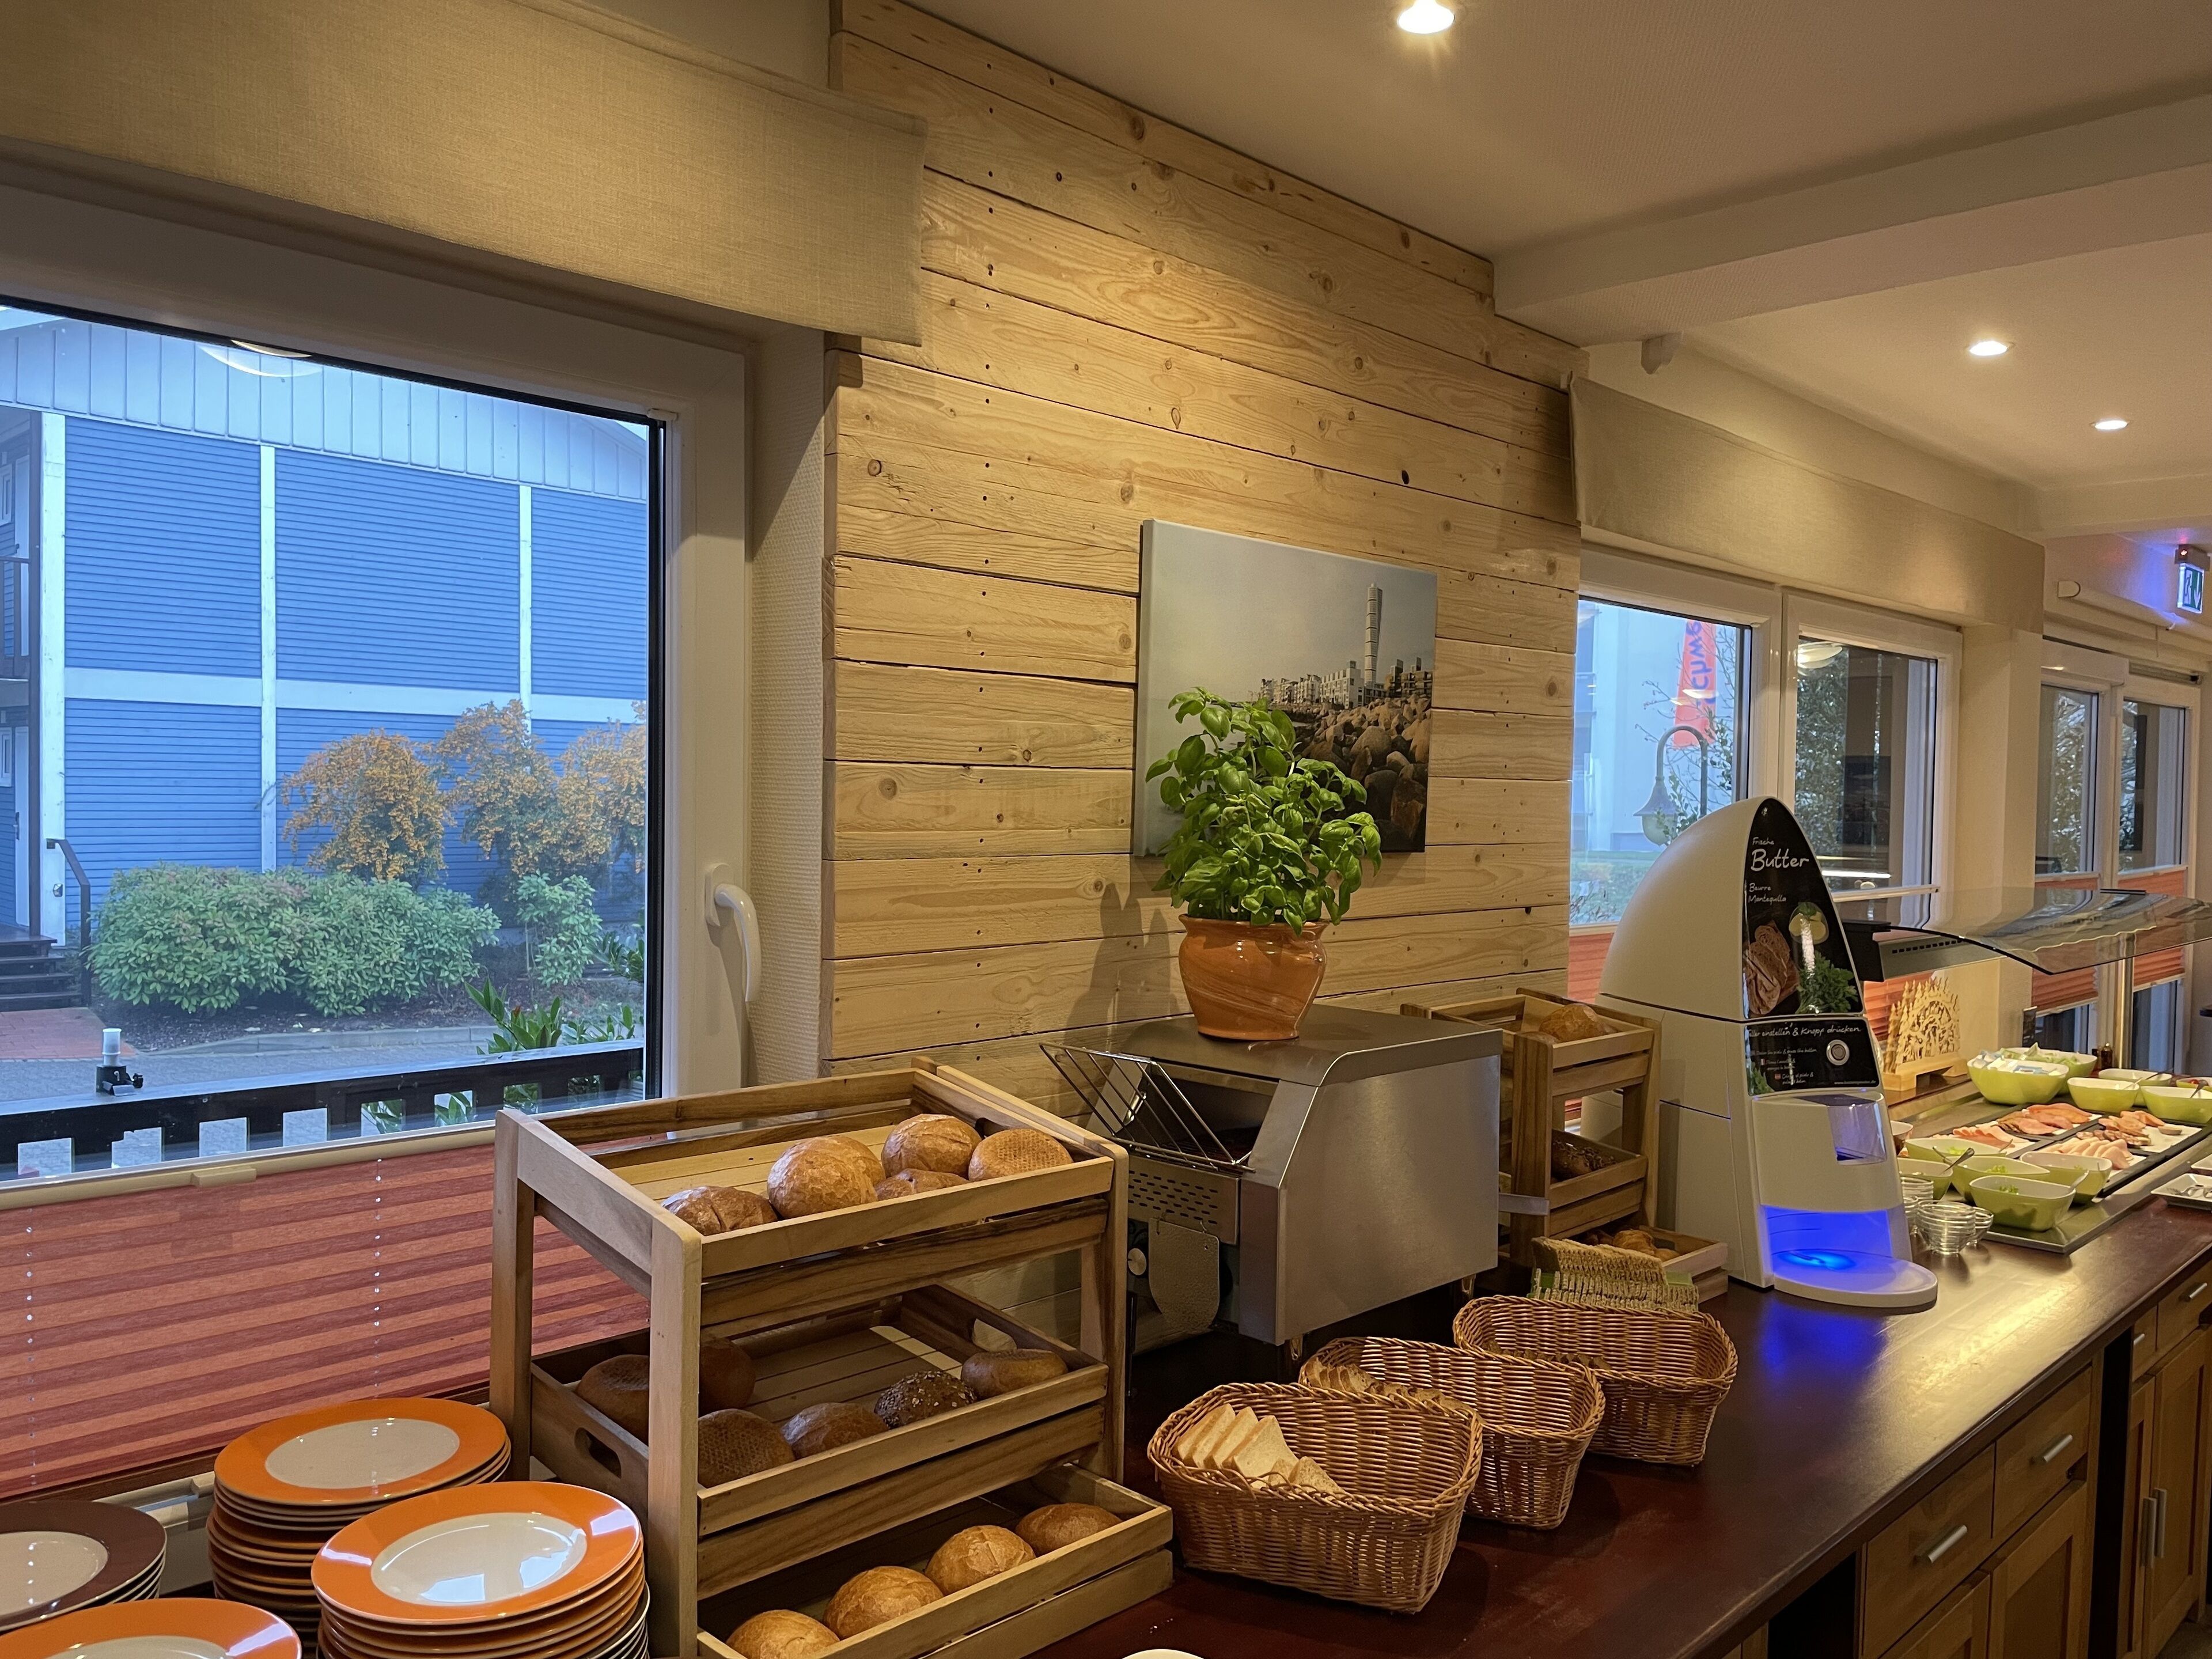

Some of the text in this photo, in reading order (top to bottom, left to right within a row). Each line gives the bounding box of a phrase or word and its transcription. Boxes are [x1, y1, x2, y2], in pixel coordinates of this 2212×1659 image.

[1752, 837, 1774, 846] Frische
[1751, 848, 1809, 872] Butter
[1749, 882, 1771, 892] Beurre
[1792, 1027, 1799, 1036] &
[1800, 1027, 1825, 1037] Knopf
